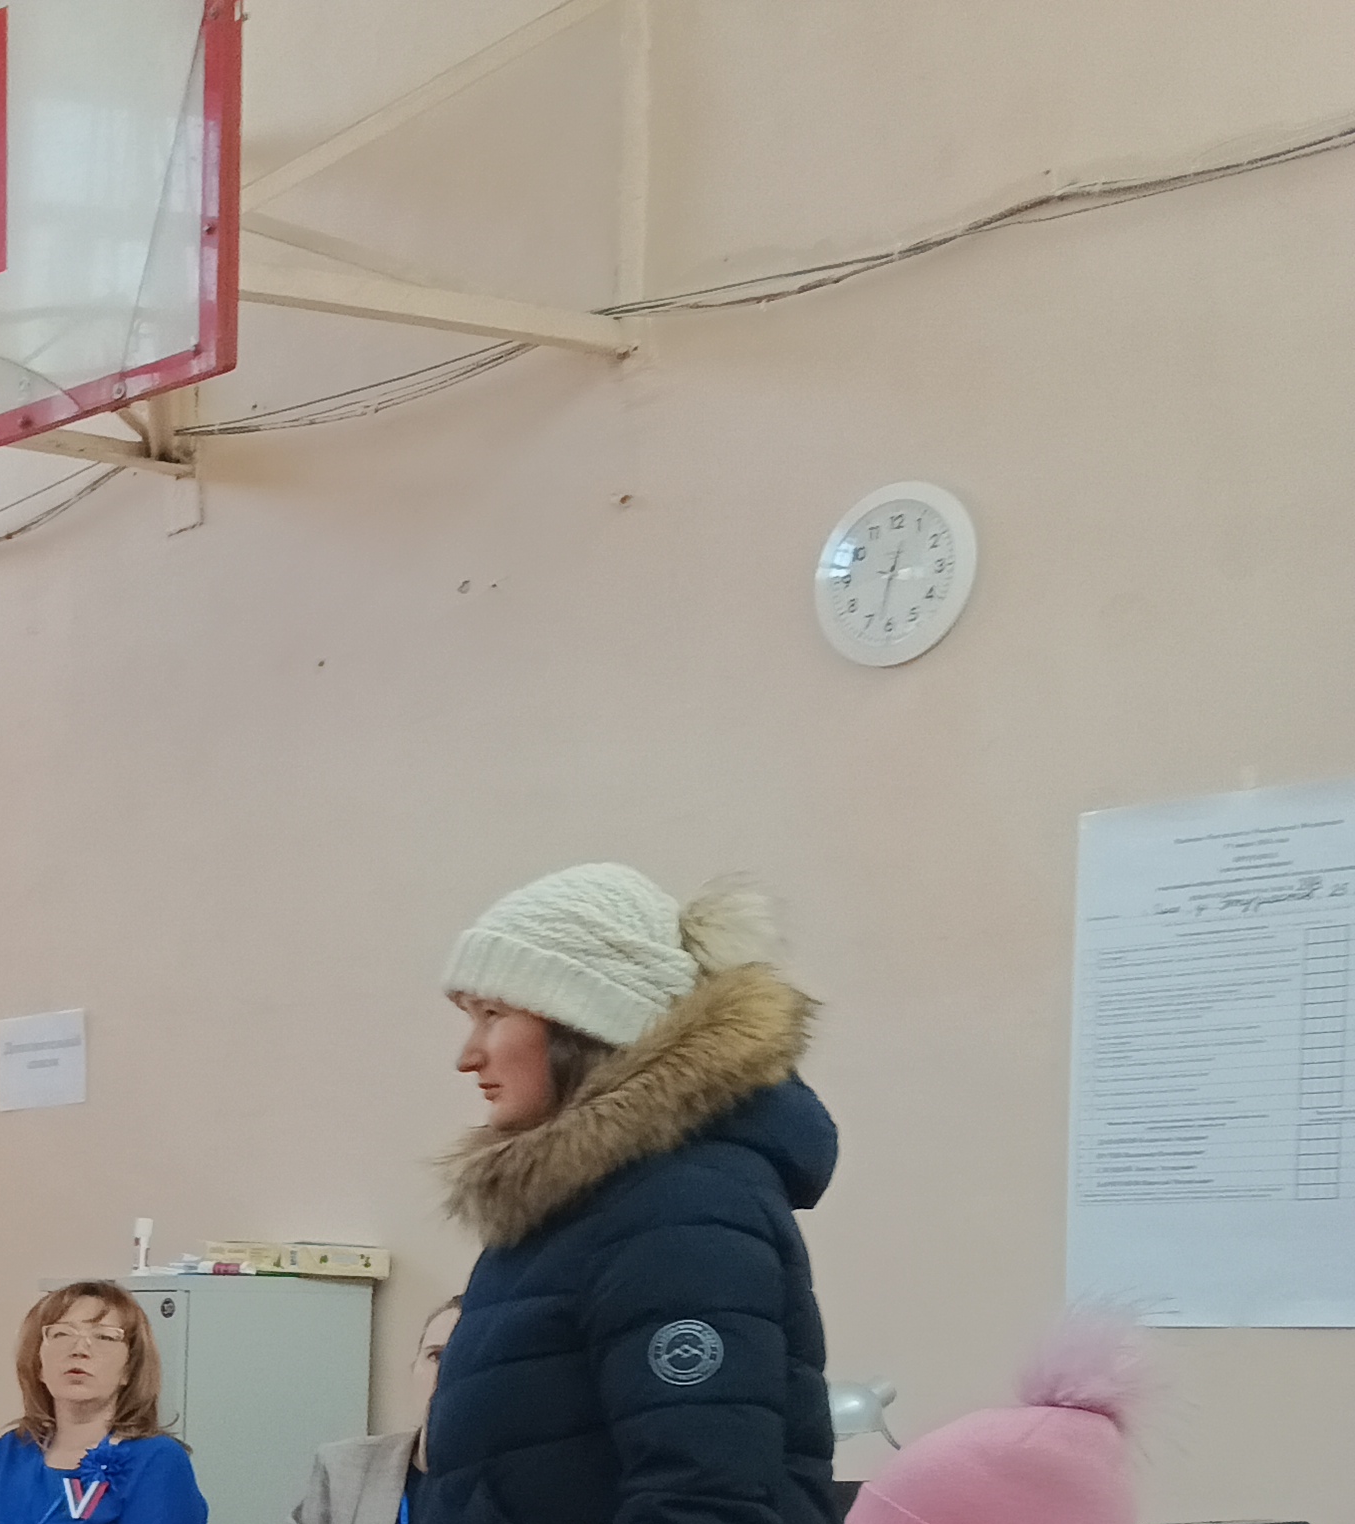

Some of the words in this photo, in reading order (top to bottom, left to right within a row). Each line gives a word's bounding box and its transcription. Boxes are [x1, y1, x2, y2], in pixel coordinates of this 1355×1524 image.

[889, 513, 905, 530] 12
[916, 517, 923, 532] 1
[928, 533, 940, 549] 2
[934, 557, 946, 573] 3
[925, 584, 937, 600] 4
[847, 598, 858, 614] 8
[907, 605, 920, 623] 5
[863, 613, 875, 631] 7
[884, 617, 895, 633] 6
